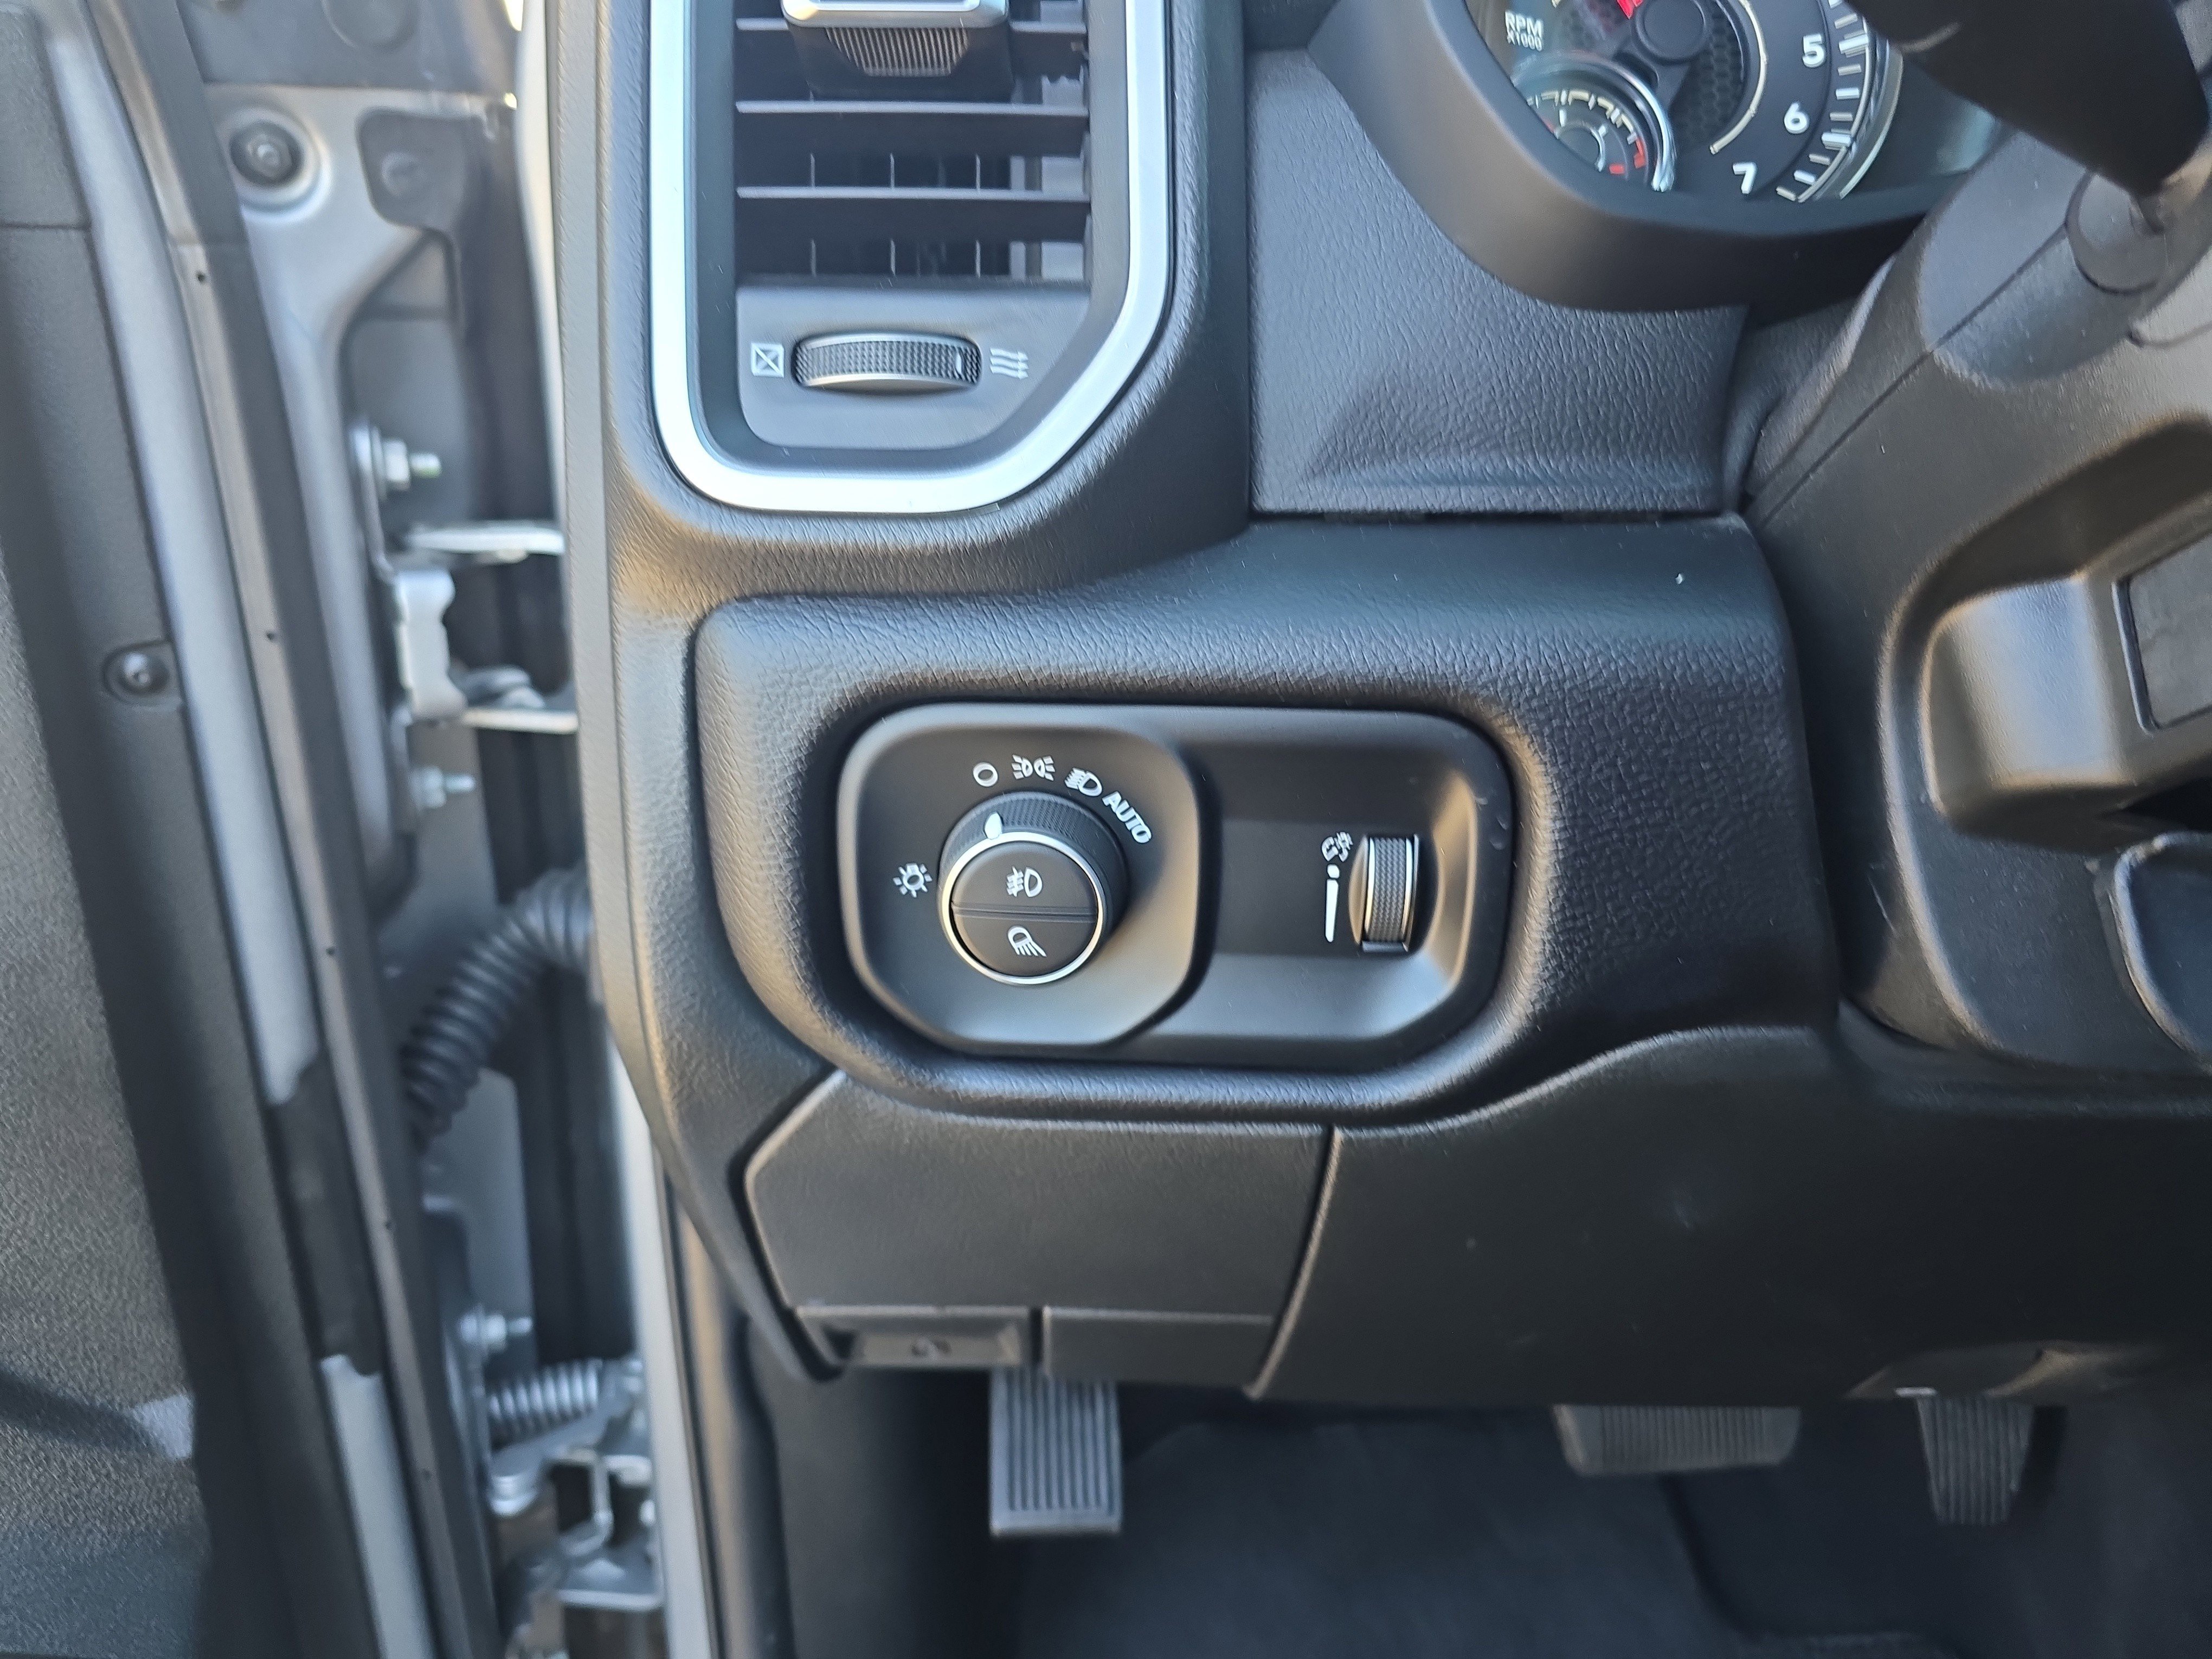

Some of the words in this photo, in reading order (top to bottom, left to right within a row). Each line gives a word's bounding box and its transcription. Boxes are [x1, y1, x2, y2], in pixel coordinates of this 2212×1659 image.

[1505, 11, 1543, 38] RPM
[1803, 34, 1825, 68] 5
[1784, 102, 1809, 133] 6
[1733, 162, 1757, 194] 7
[1102, 792, 1152, 843] AUTO
